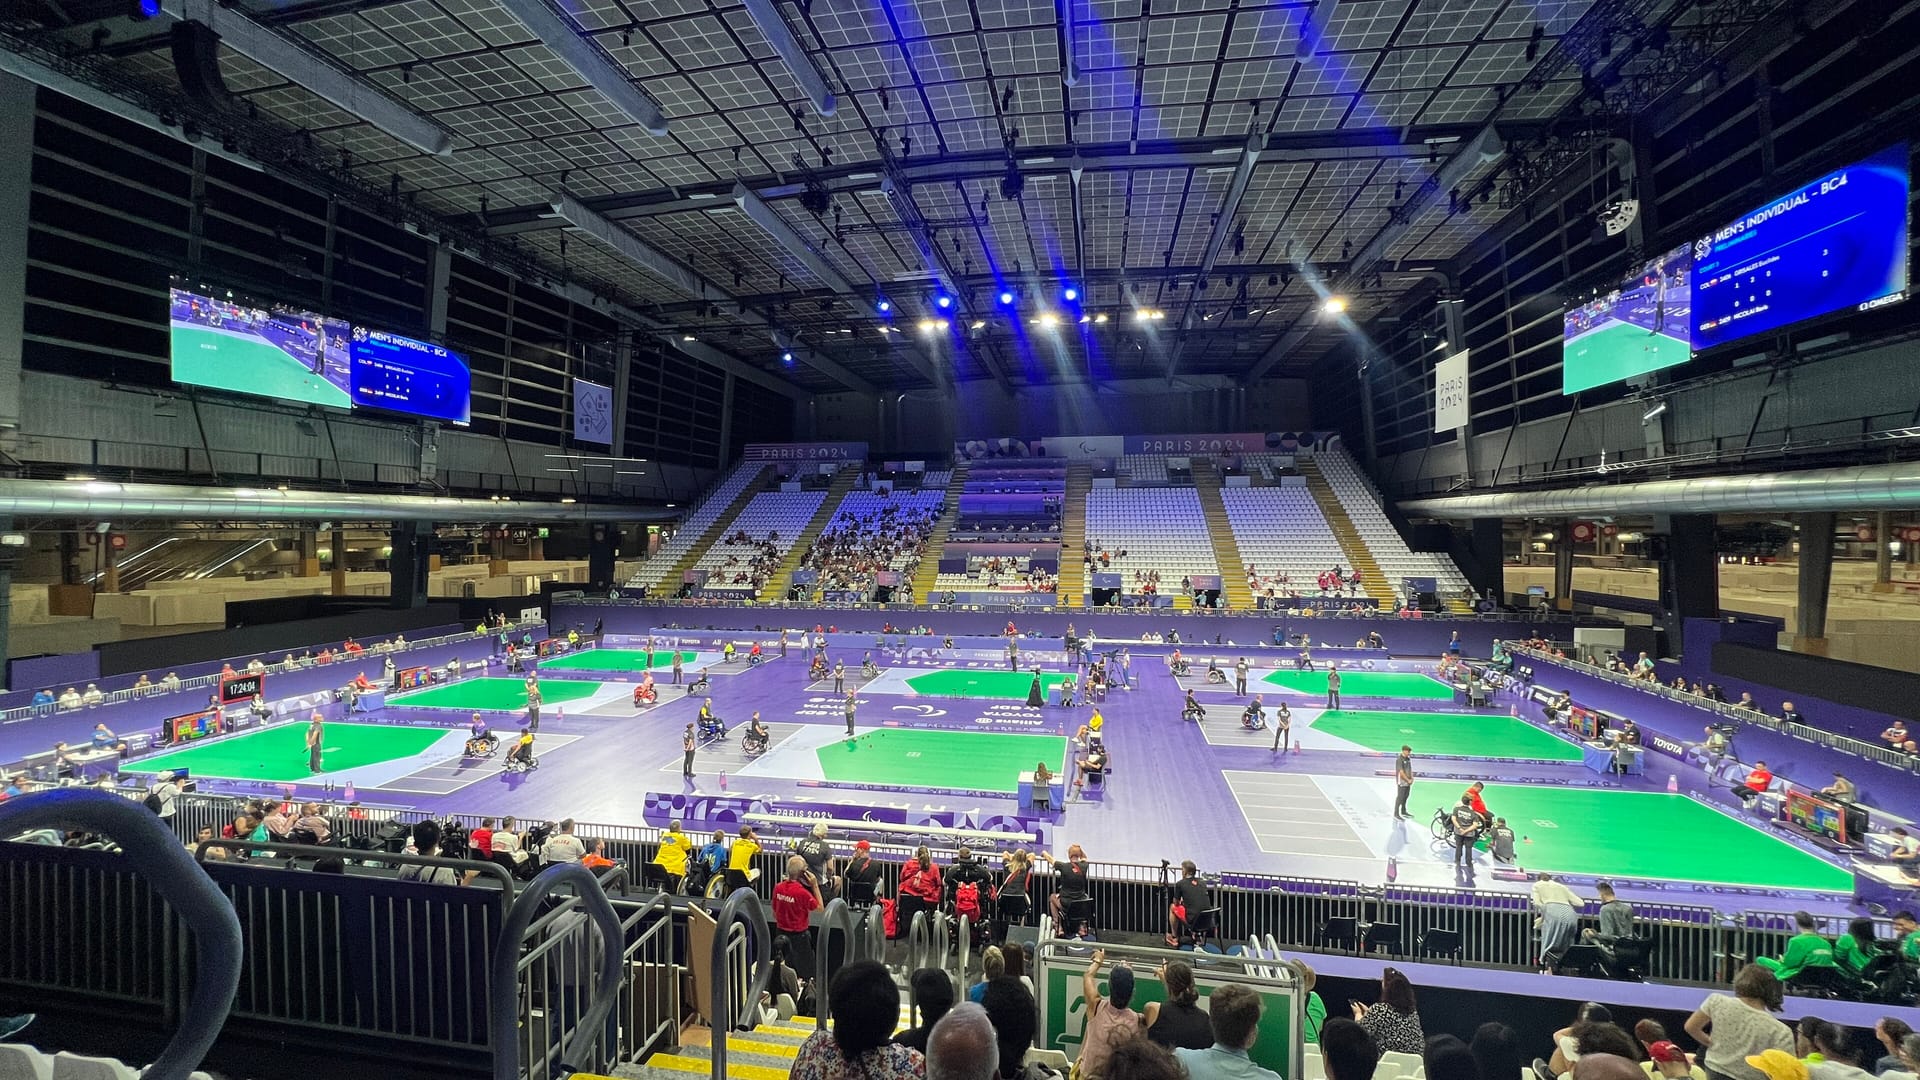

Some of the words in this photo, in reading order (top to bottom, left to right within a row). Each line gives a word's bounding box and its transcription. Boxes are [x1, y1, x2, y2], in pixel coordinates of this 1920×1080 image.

[1714, 221, 1745, 243] MEN'S
[1746, 192, 1810, 228] INDIVIDUAL
[1820, 172, 1848, 195] BC4
[1700, 282, 1710, 290] COL
[1869, 293, 1903, 309] OMEGA
[370, 331, 391, 343] MEN'S
[393, 338, 430, 353] INDIVIDUAL
[1440, 376, 1463, 395] PARIS
[1440, 393, 1463, 410] 2024
[762, 449, 803, 459] PARIS
[809, 448, 848, 458] 2024
[1143, 440, 1192, 452] PARIS
[1199, 440, 1245, 451] 2024
[1653, 737, 1683, 756] TOYOTA
[776, 808, 804, 817] PARIS
[806, 811, 834, 820] 2024
